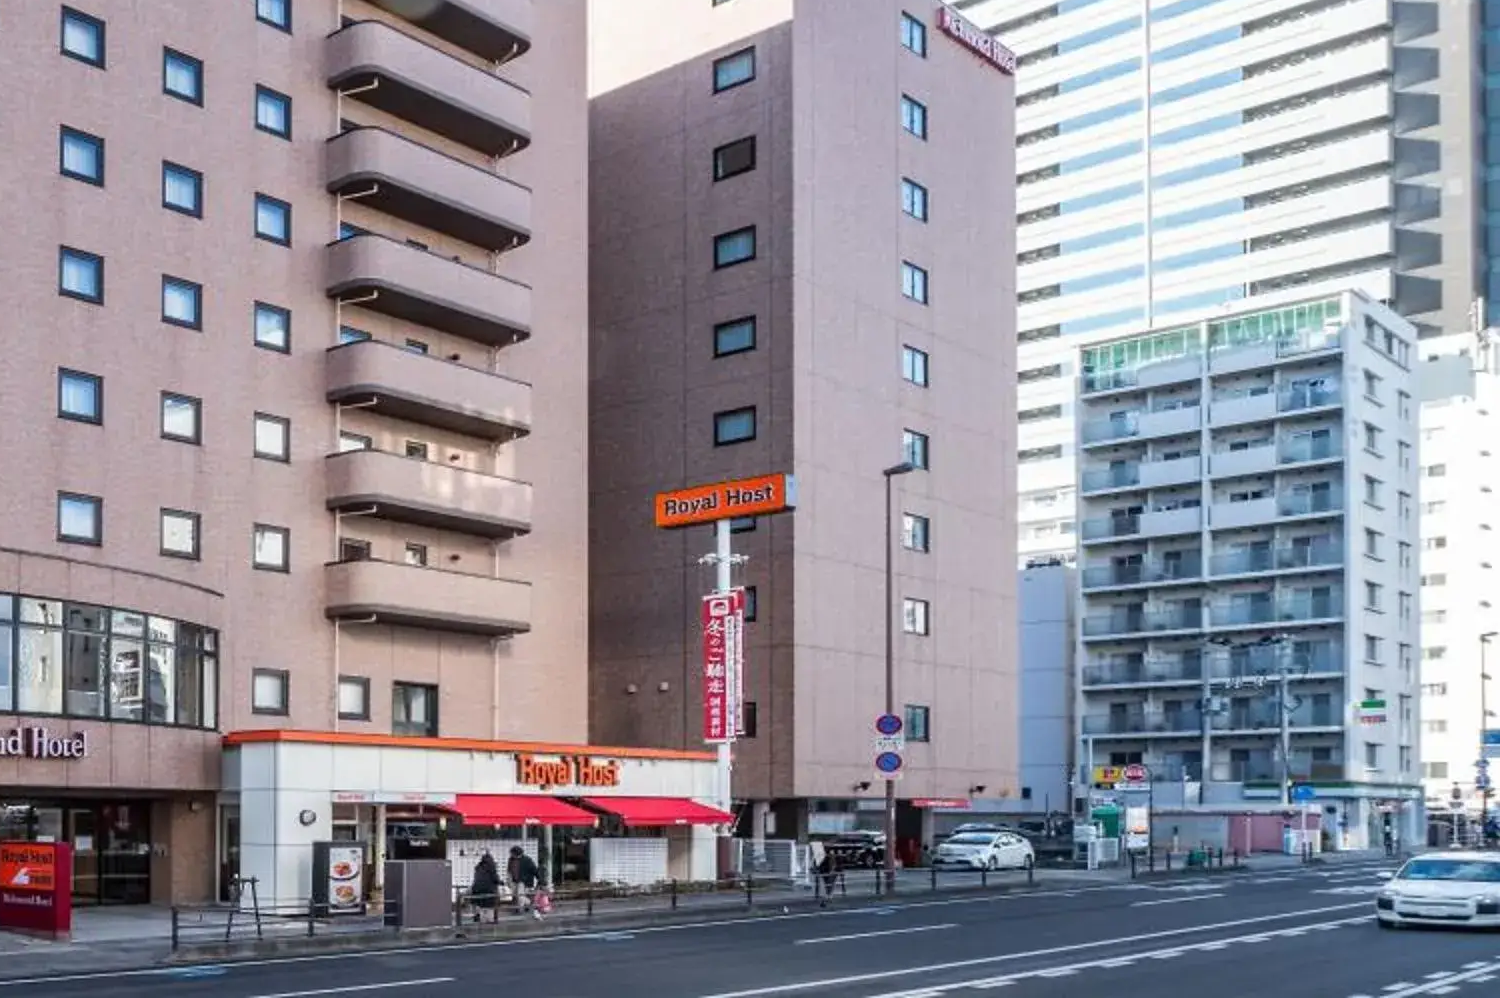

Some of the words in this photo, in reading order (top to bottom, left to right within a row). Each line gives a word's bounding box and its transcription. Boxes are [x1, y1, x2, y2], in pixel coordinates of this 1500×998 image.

[665, 490, 718, 516] Royal
[726, 483, 774, 506] Host
[32, 727, 88, 758] Hotel
[516, 753, 572, 790] Royal
[575, 755, 620, 787] Host
